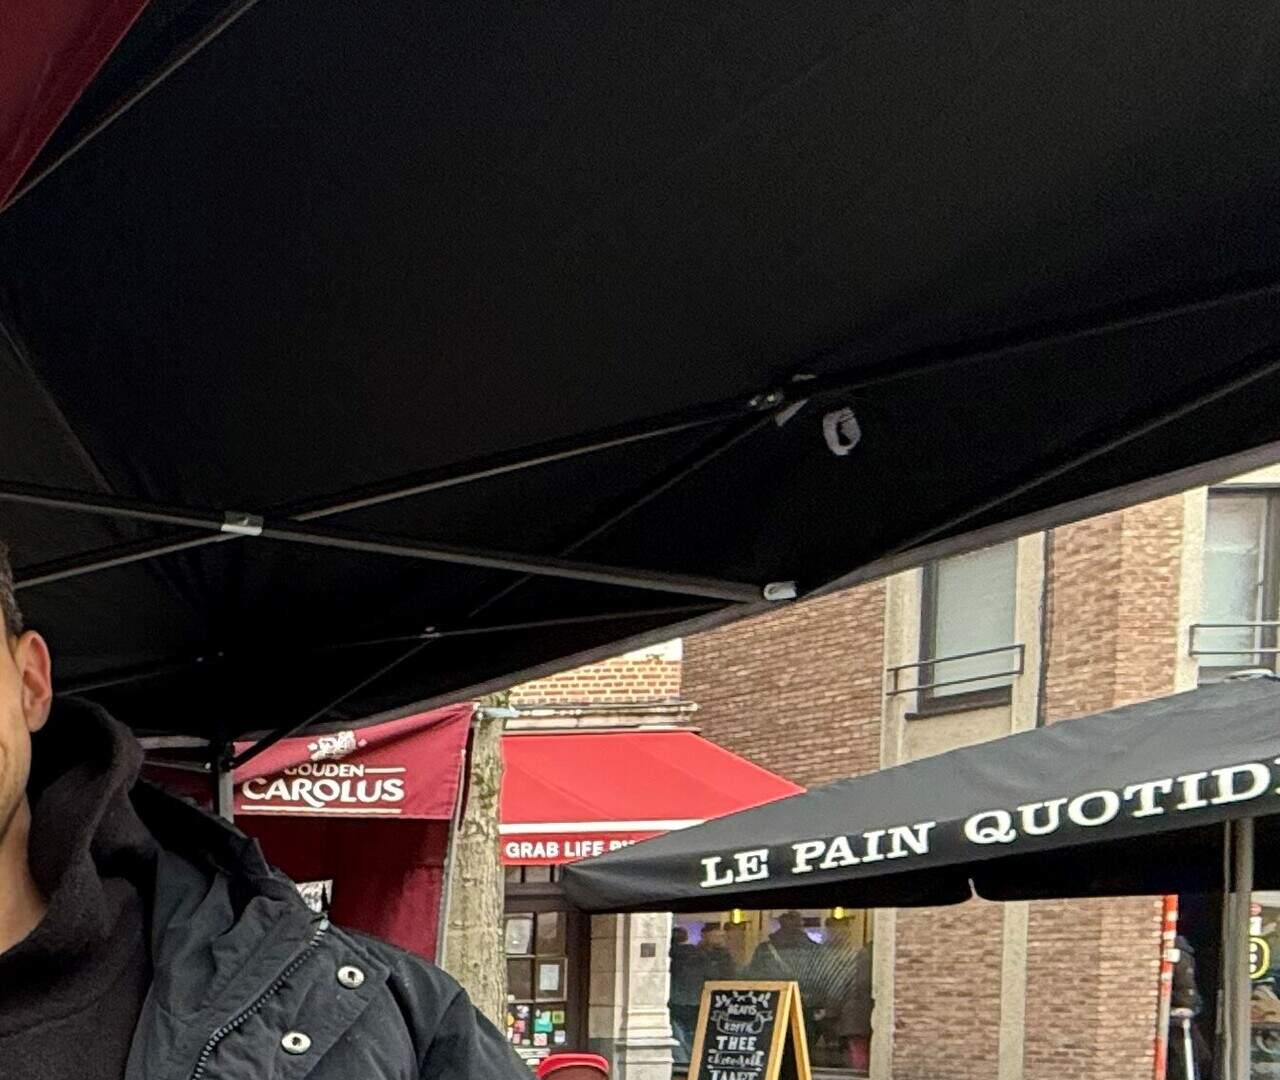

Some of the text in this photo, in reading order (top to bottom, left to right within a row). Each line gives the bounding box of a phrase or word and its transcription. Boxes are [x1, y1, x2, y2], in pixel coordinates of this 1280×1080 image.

[242, 778, 405, 808] CAROLUS
[700, 757, 1280, 888] LE PAIN QUOTID
[505, 841, 559, 858] GRAB
[564, 840, 603, 857] LIFE
[716, 1036, 757, 1051] THEE
